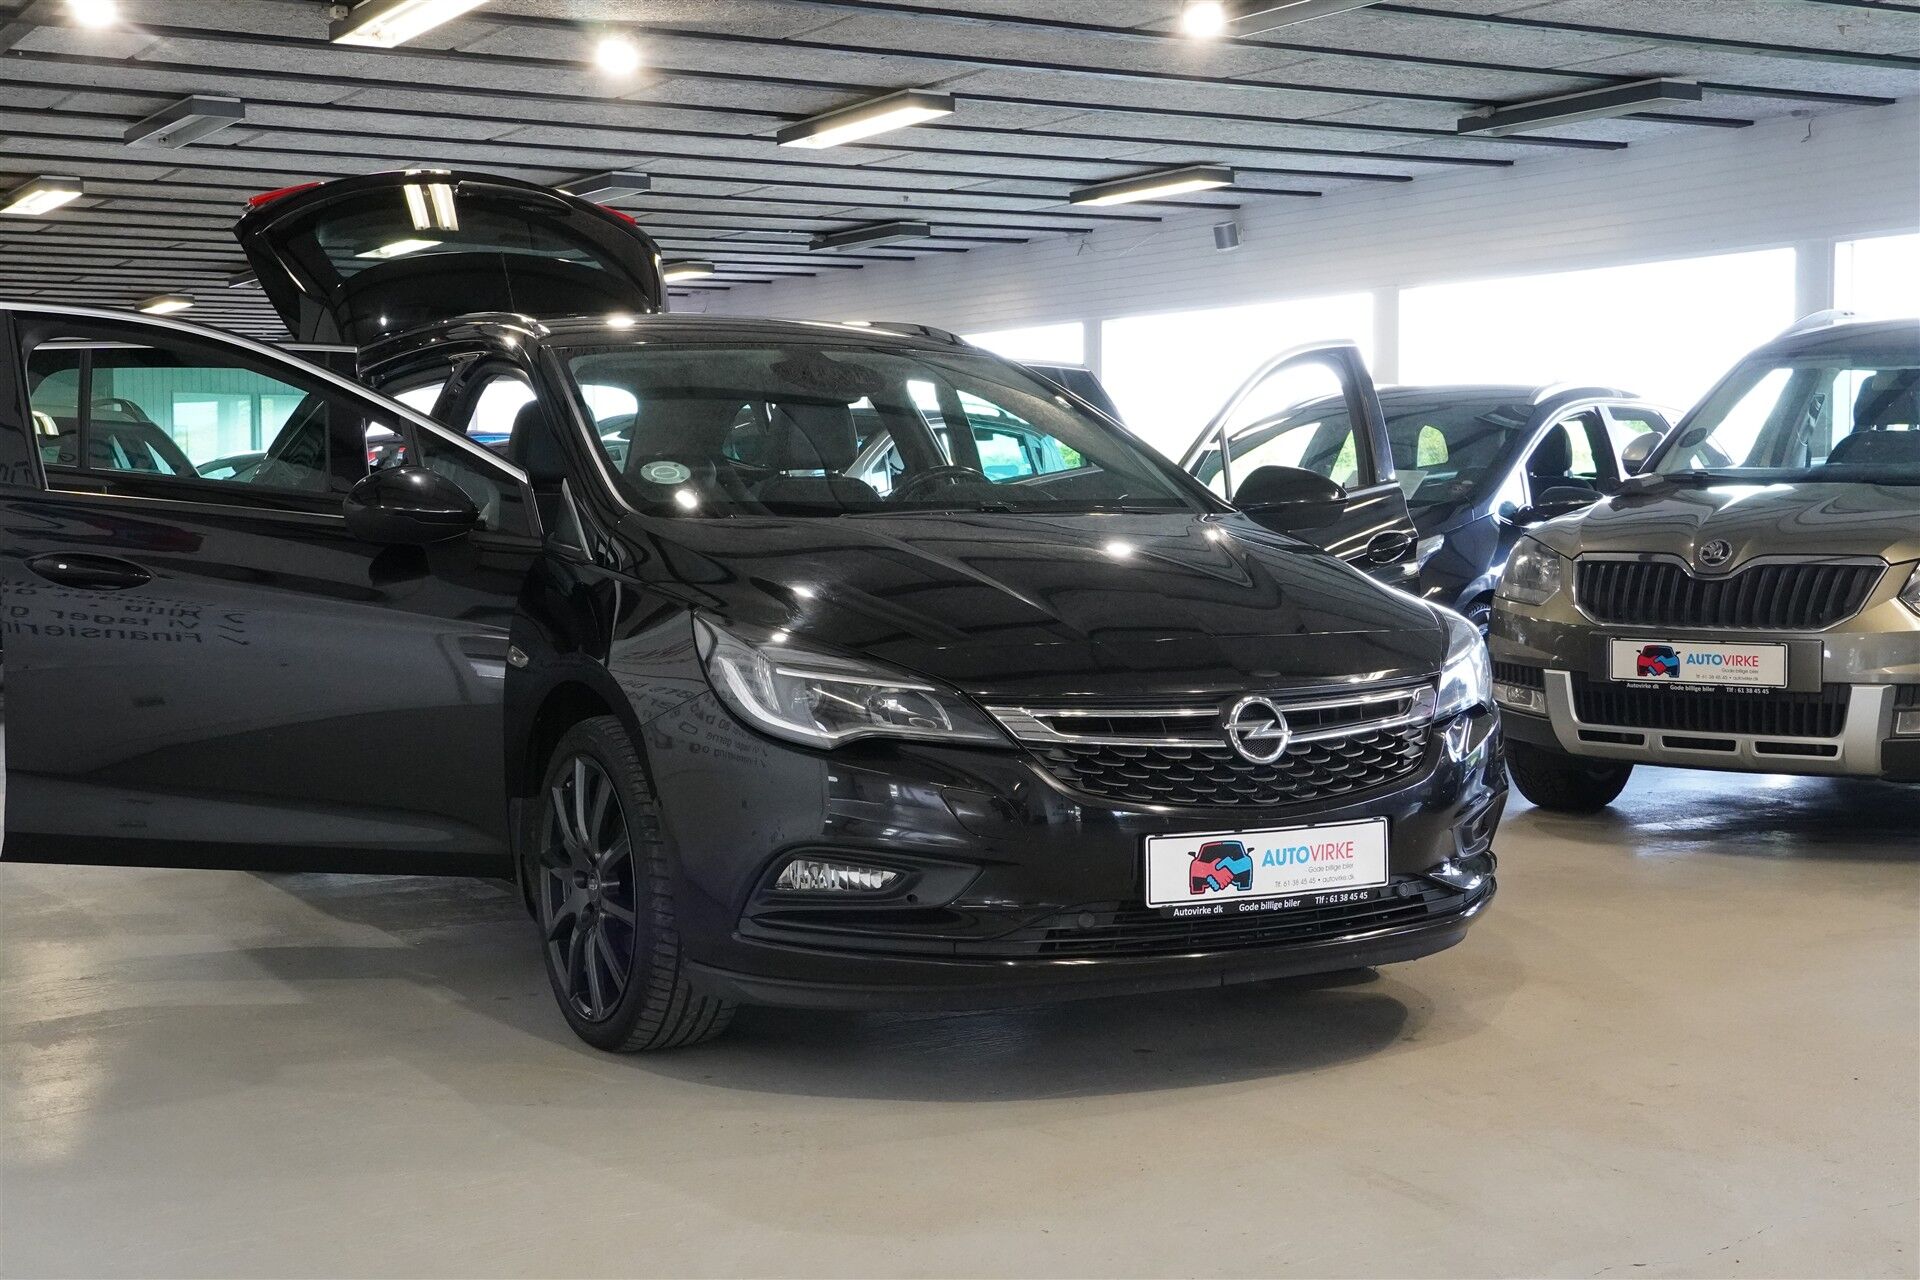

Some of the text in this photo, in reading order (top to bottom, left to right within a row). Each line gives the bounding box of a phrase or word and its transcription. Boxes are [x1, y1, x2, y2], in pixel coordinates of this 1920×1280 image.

[1686, 653, 1759, 667] AUTOVIRKE
[1685, 684, 1701, 692] billige
[1261, 841, 1354, 867] AUTOVIRKE
[1308, 862, 1354, 873] Gode billige biler
[1308, 876, 1316, 884] 45
[1173, 906, 1212, 917] Autovirke
[1213, 905, 1223, 914] dk
[1239, 902, 1259, 912] Gode
[1260, 900, 1283, 911] billige
[1283, 899, 1301, 908] biler
[1329, 895, 1338, 903] 61
[1339, 894, 1348, 902] 38
[1349, 893, 1358, 901] 45
[1359, 892, 1368, 900] 45
